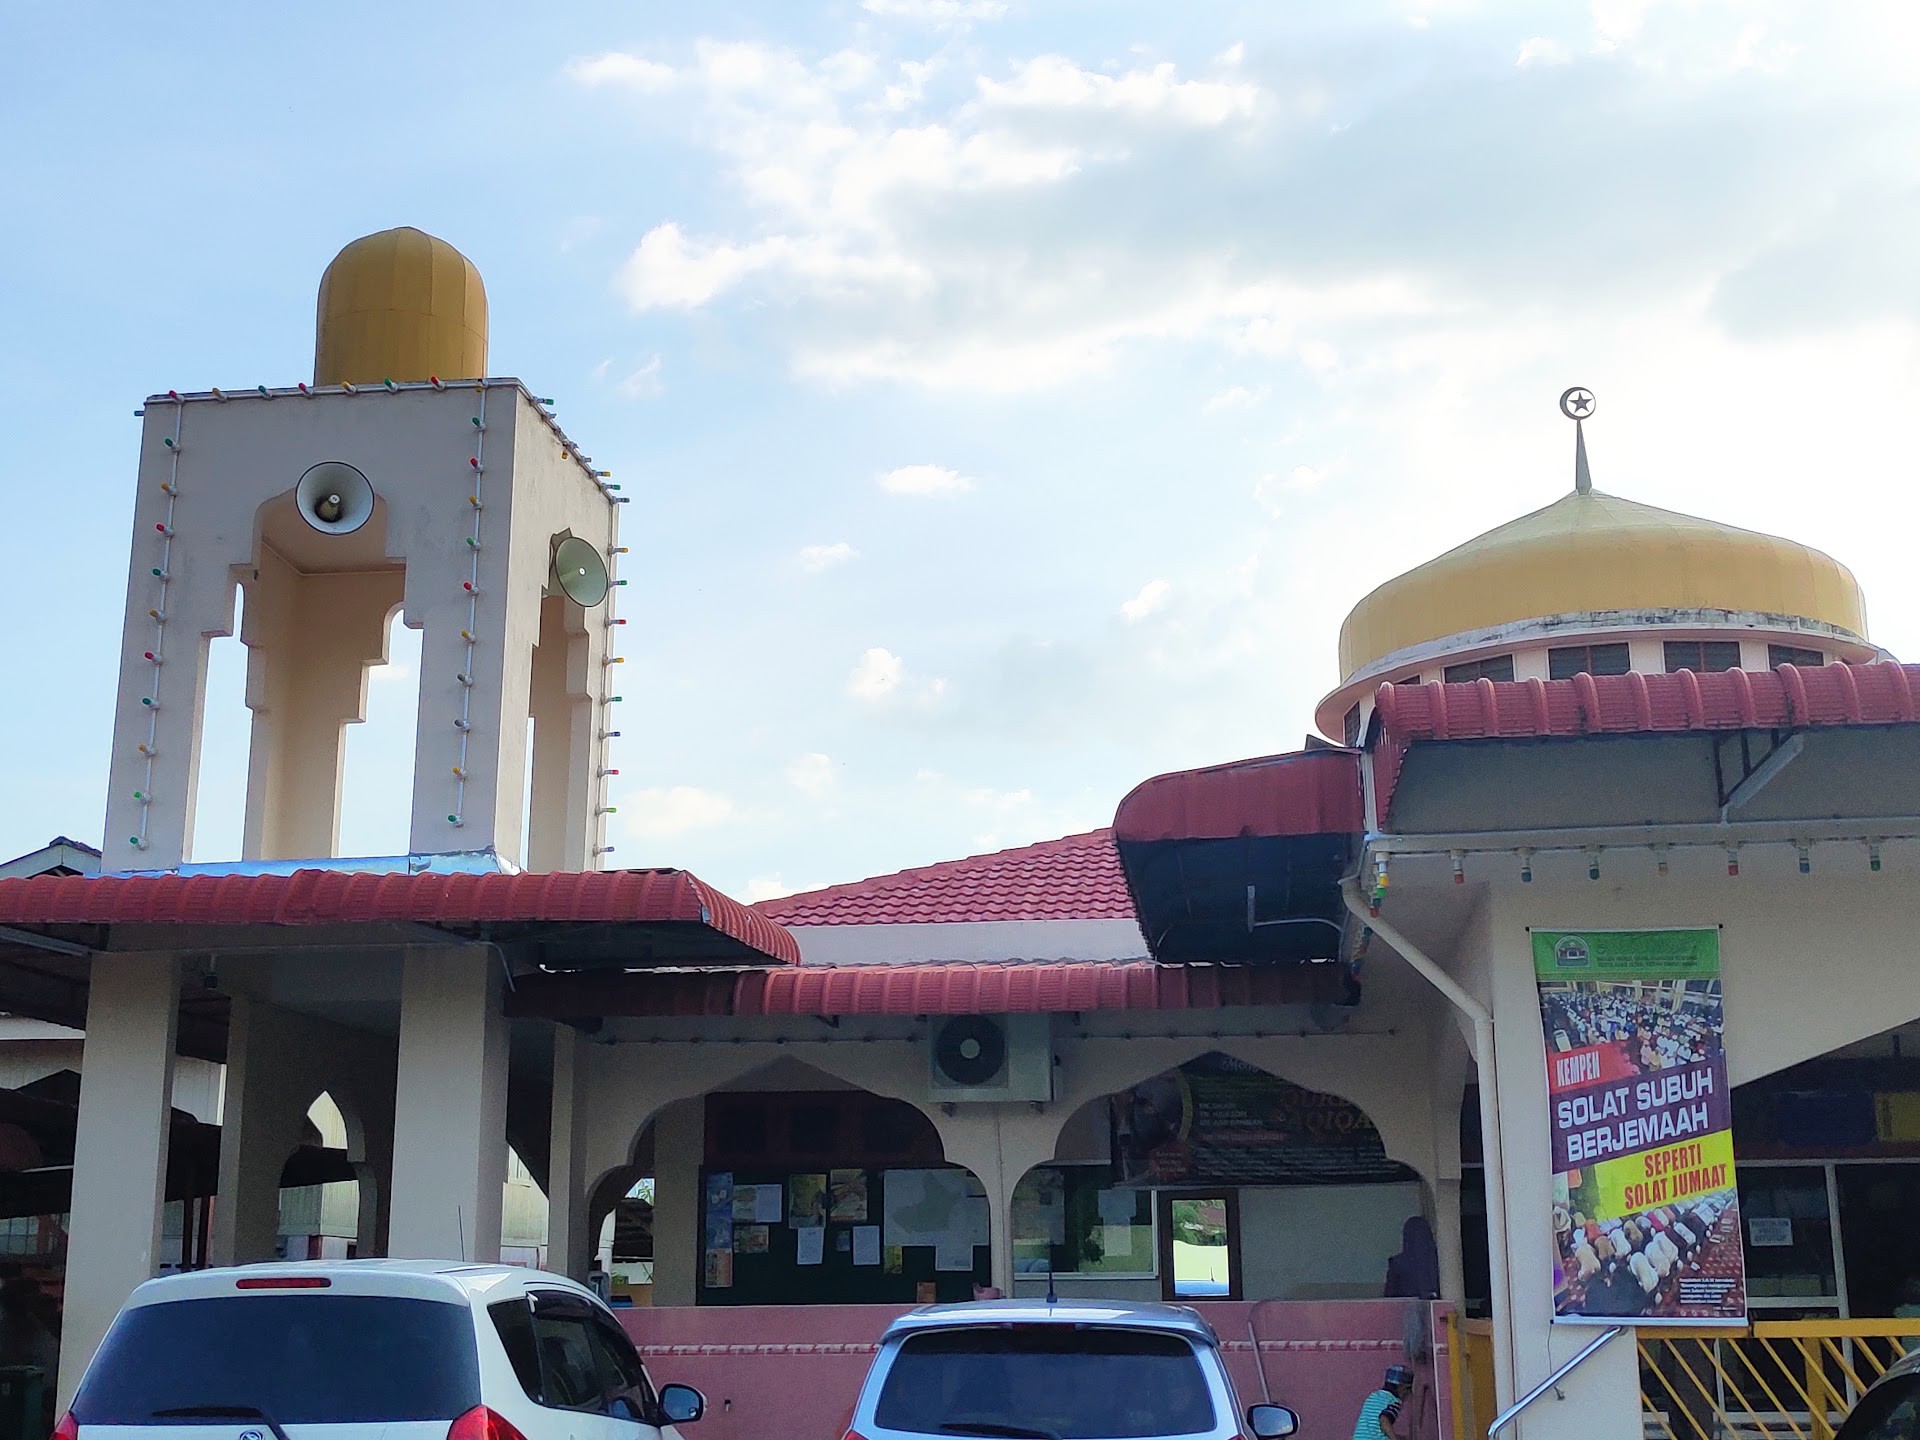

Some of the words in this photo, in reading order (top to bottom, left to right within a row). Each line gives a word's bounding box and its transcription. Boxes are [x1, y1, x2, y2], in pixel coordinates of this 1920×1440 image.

[1556, 1052, 1600, 1087] KEMPEN
[1558, 1087, 1629, 1128] SOLAT
[1636, 1067, 1713, 1110] SUBUH
[1567, 1102, 1709, 1162] BERJEMAAH
[1644, 1143, 1702, 1178] SEPERTI
[1624, 1177, 1668, 1209] SOLAT
[1672, 1164, 1727, 1198] JUMAAT
